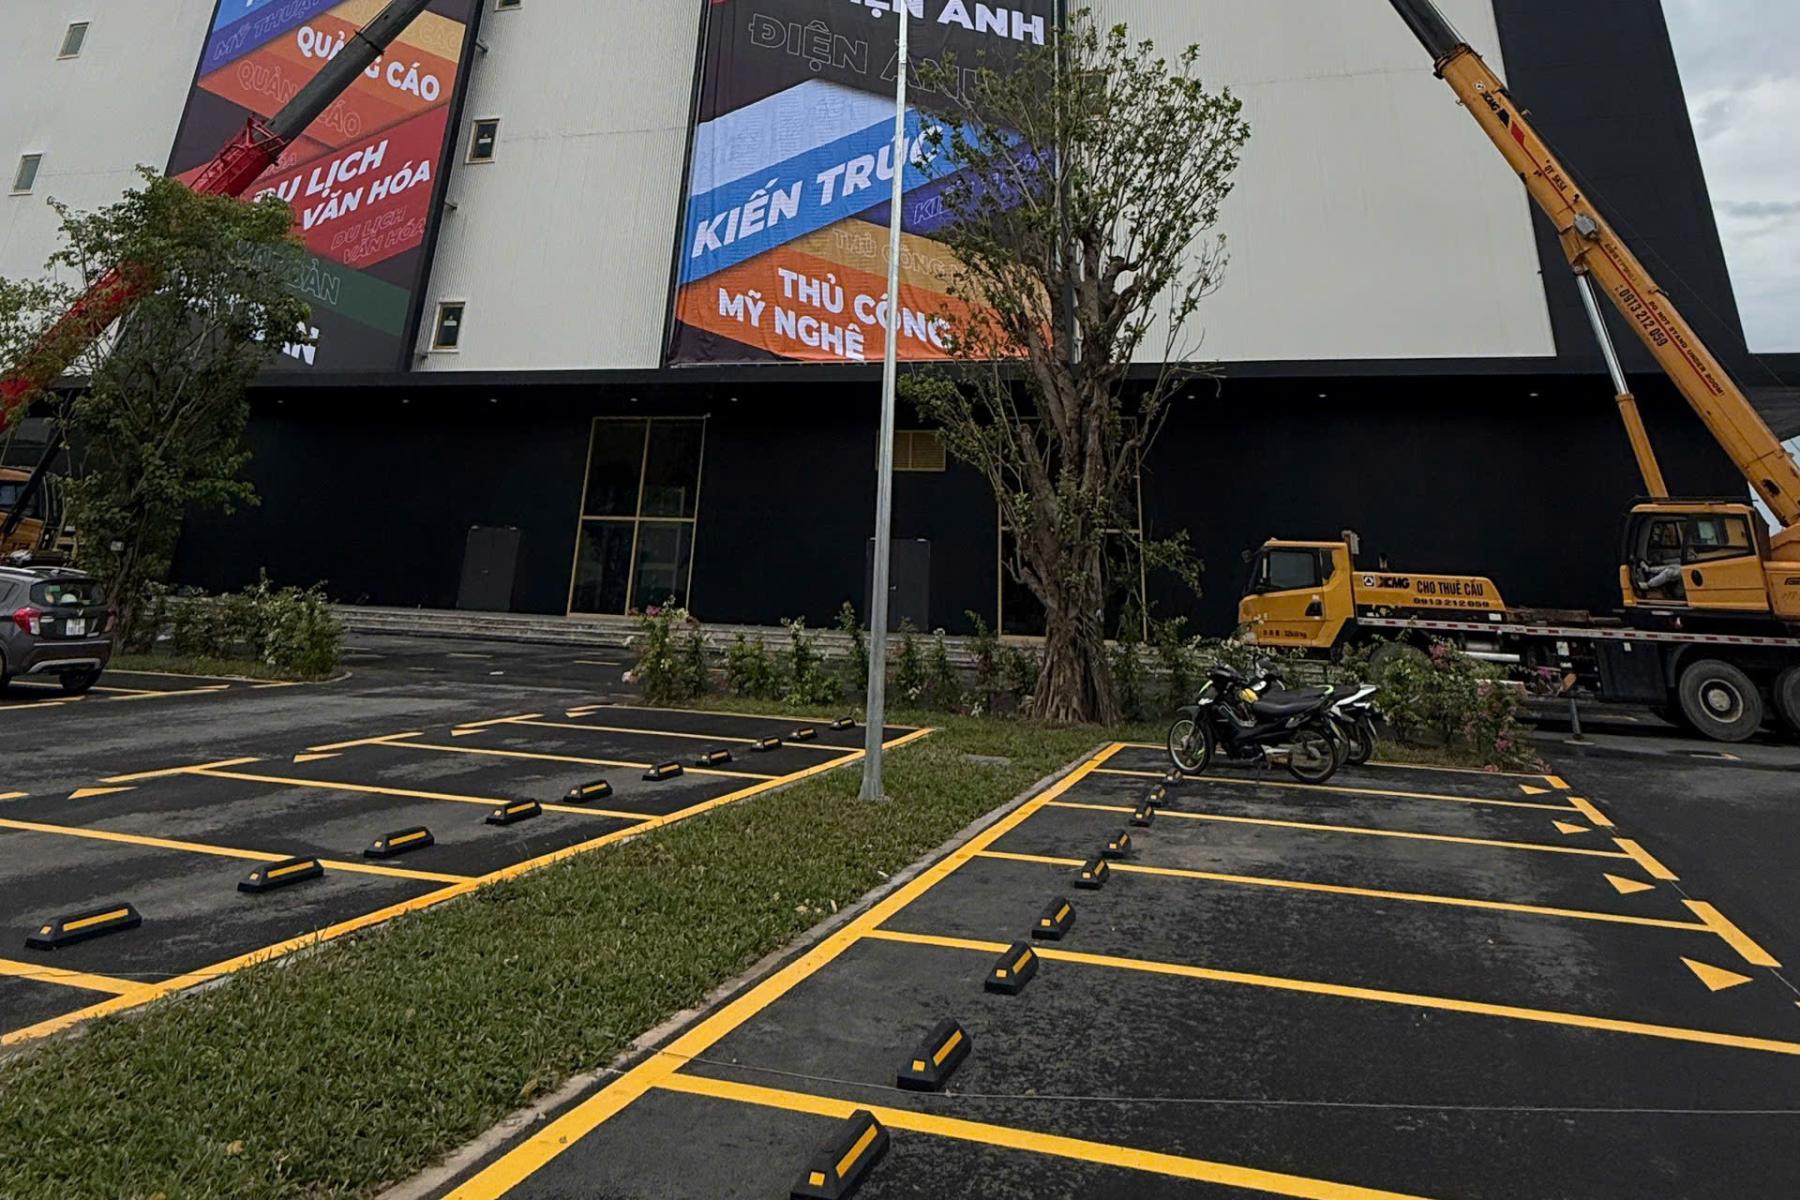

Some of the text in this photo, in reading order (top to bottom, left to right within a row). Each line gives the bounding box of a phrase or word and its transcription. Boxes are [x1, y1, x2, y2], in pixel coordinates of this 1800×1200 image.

[747, 12, 870, 74] ĐIỆN
[386, 60, 441, 102] CÁO
[302, 159, 433, 232] VĂN HÓA
[304, 139, 390, 200] LỊCH
[690, 176, 804, 260] KIẾN
[814, 123, 946, 208] TRÚC
[718, 287, 766, 328] MỸ
[777, 265, 953, 349] THỦ CÔNG
[1619, 289, 1640, 316] 0913
[1635, 310, 1655, 330] 212
[1649, 328, 1669, 347] 059
[1416, 580, 1436, 594] CHO
